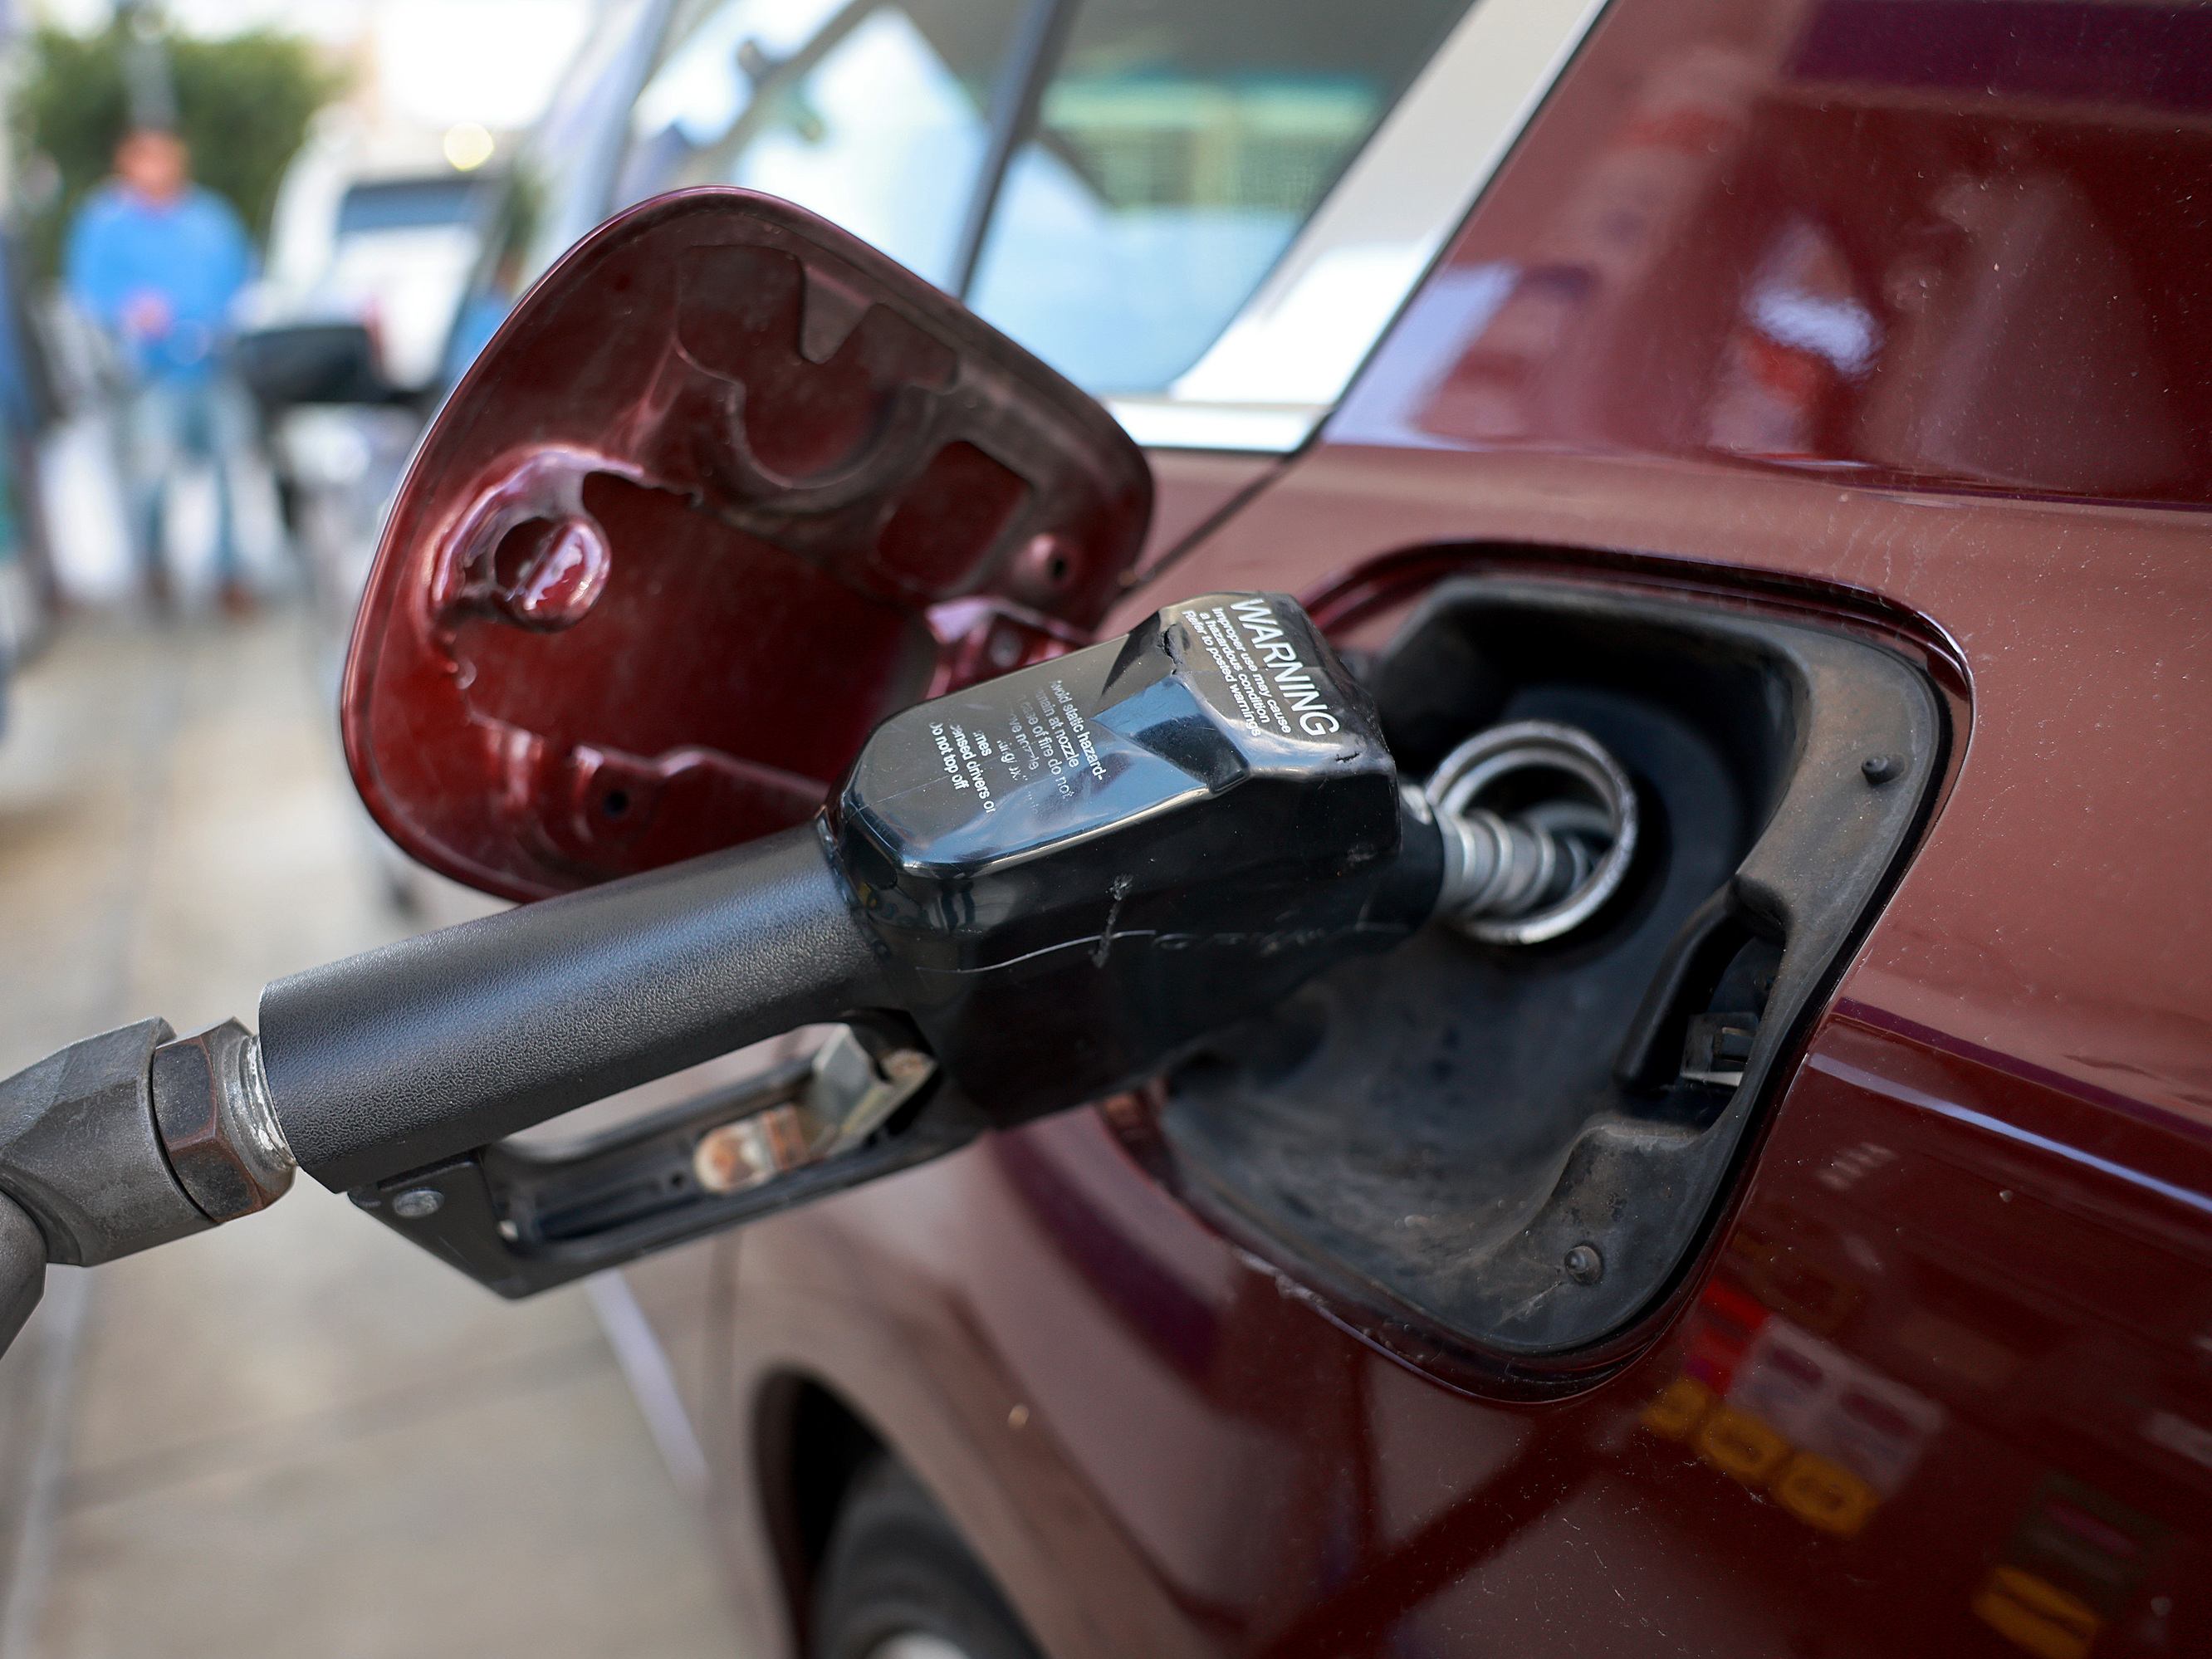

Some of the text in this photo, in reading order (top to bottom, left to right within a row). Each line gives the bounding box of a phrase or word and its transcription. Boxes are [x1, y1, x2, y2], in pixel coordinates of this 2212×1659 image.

[1182, 609, 1261, 737] Refer to posted warnings
[1199, 612, 1270, 723] a hazardous condition
[1211, 607, 1291, 733] Improper use may cause
[1230, 598, 1341, 737] WARNING
[1032, 726, 1049, 737] of
[1048, 717, 1064, 730] at
[935, 736, 954, 756] not
[1038, 737, 1054, 757] fire
[1055, 729, 1079, 767] nozzle
[1063, 704, 1084, 732] static
[1077, 732, 1107, 781] hazard-
[943, 754, 959, 773] top
[1048, 759, 1063, 775] do
[952, 774, 970, 790] off
[966, 761, 990, 799] drivers
